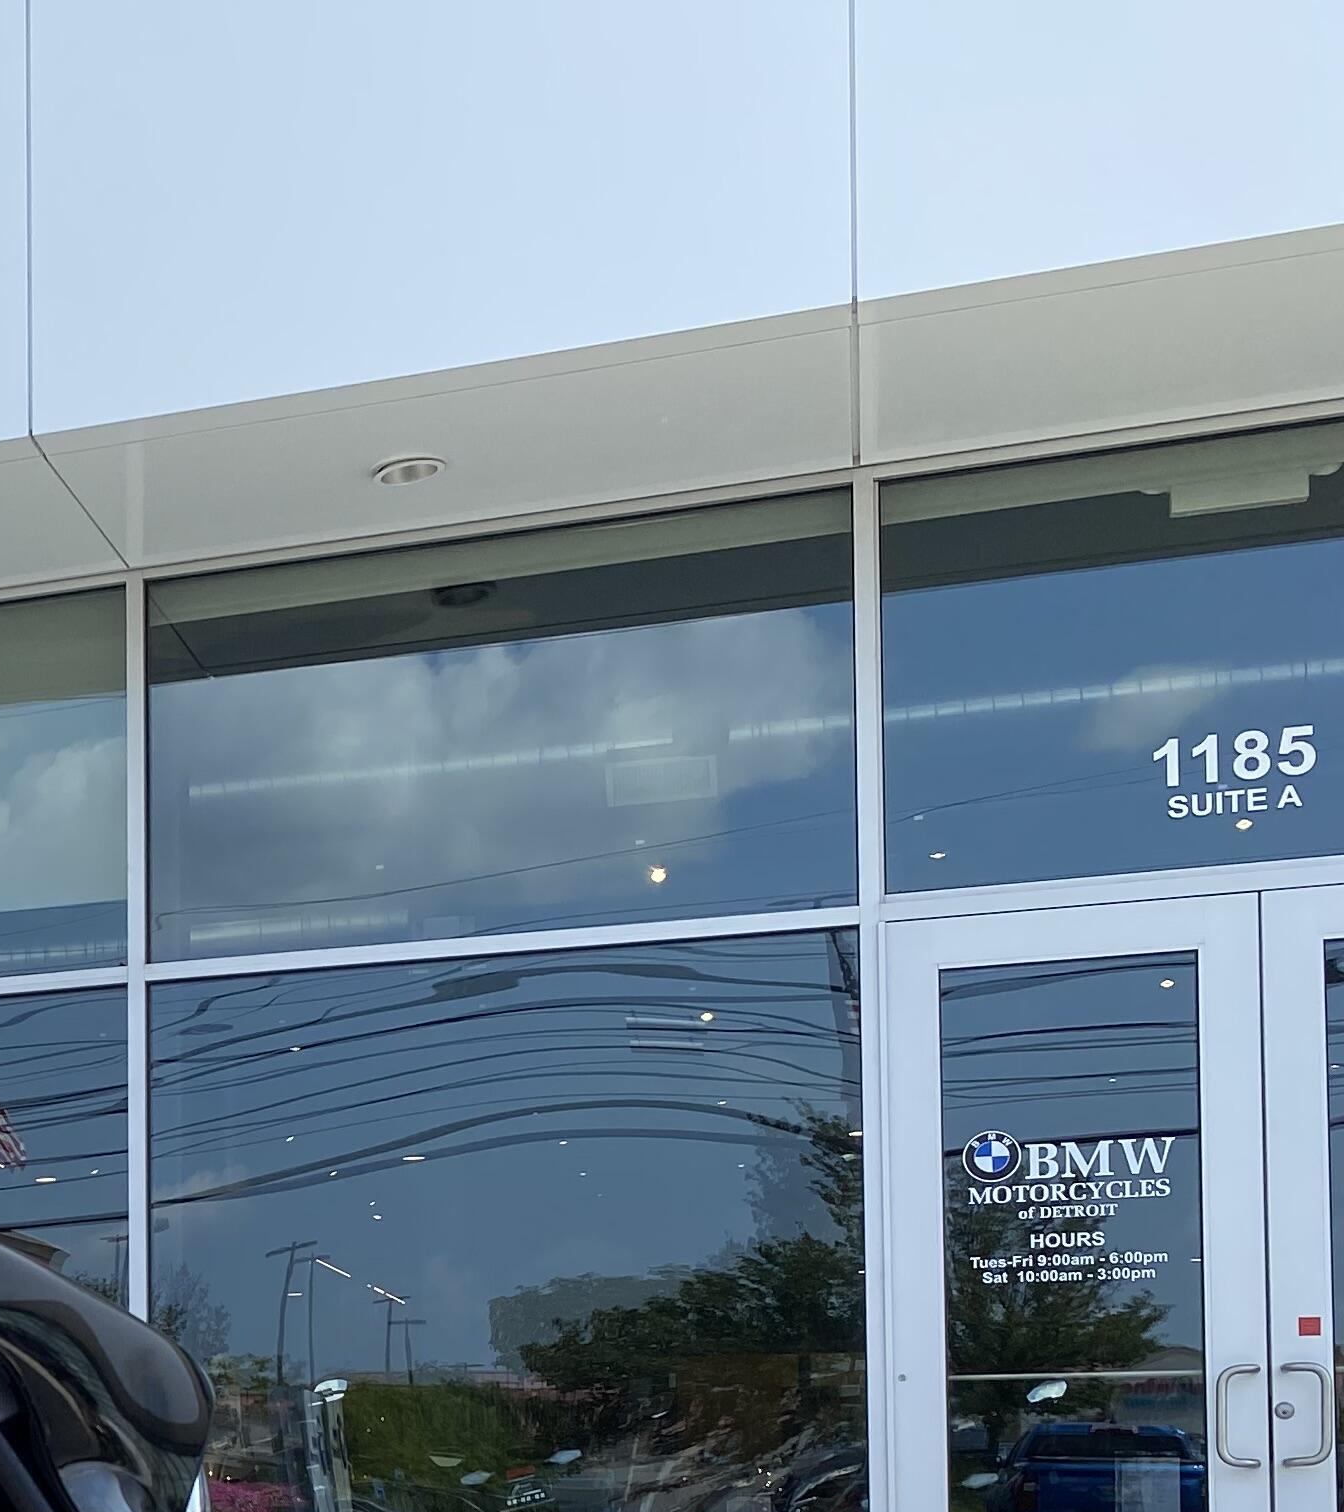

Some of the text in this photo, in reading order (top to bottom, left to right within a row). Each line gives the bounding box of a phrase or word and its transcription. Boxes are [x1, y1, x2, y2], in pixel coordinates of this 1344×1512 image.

[1152, 724, 1317, 787] 1185
[1167, 785, 1303, 819] SUITE A
[1025, 1137, 1176, 1180] BMW
[968, 1179, 1171, 1205] MOTORCYCLES
[1018, 1203, 1118, 1220] of DETROIT
[1030, 1232, 1106, 1249] HOURS
[970, 1254, 1033, 1269] Tues-Fri
[1037, 1254, 1095, 1267] 9:00am
[1109, 1252, 1169, 1265] 6:00pm
[982, 1270, 1008, 1284] Sat
[1017, 1269, 1082, 1283] 10:00am
[1097, 1267, 1156, 1281] 3:00pm
